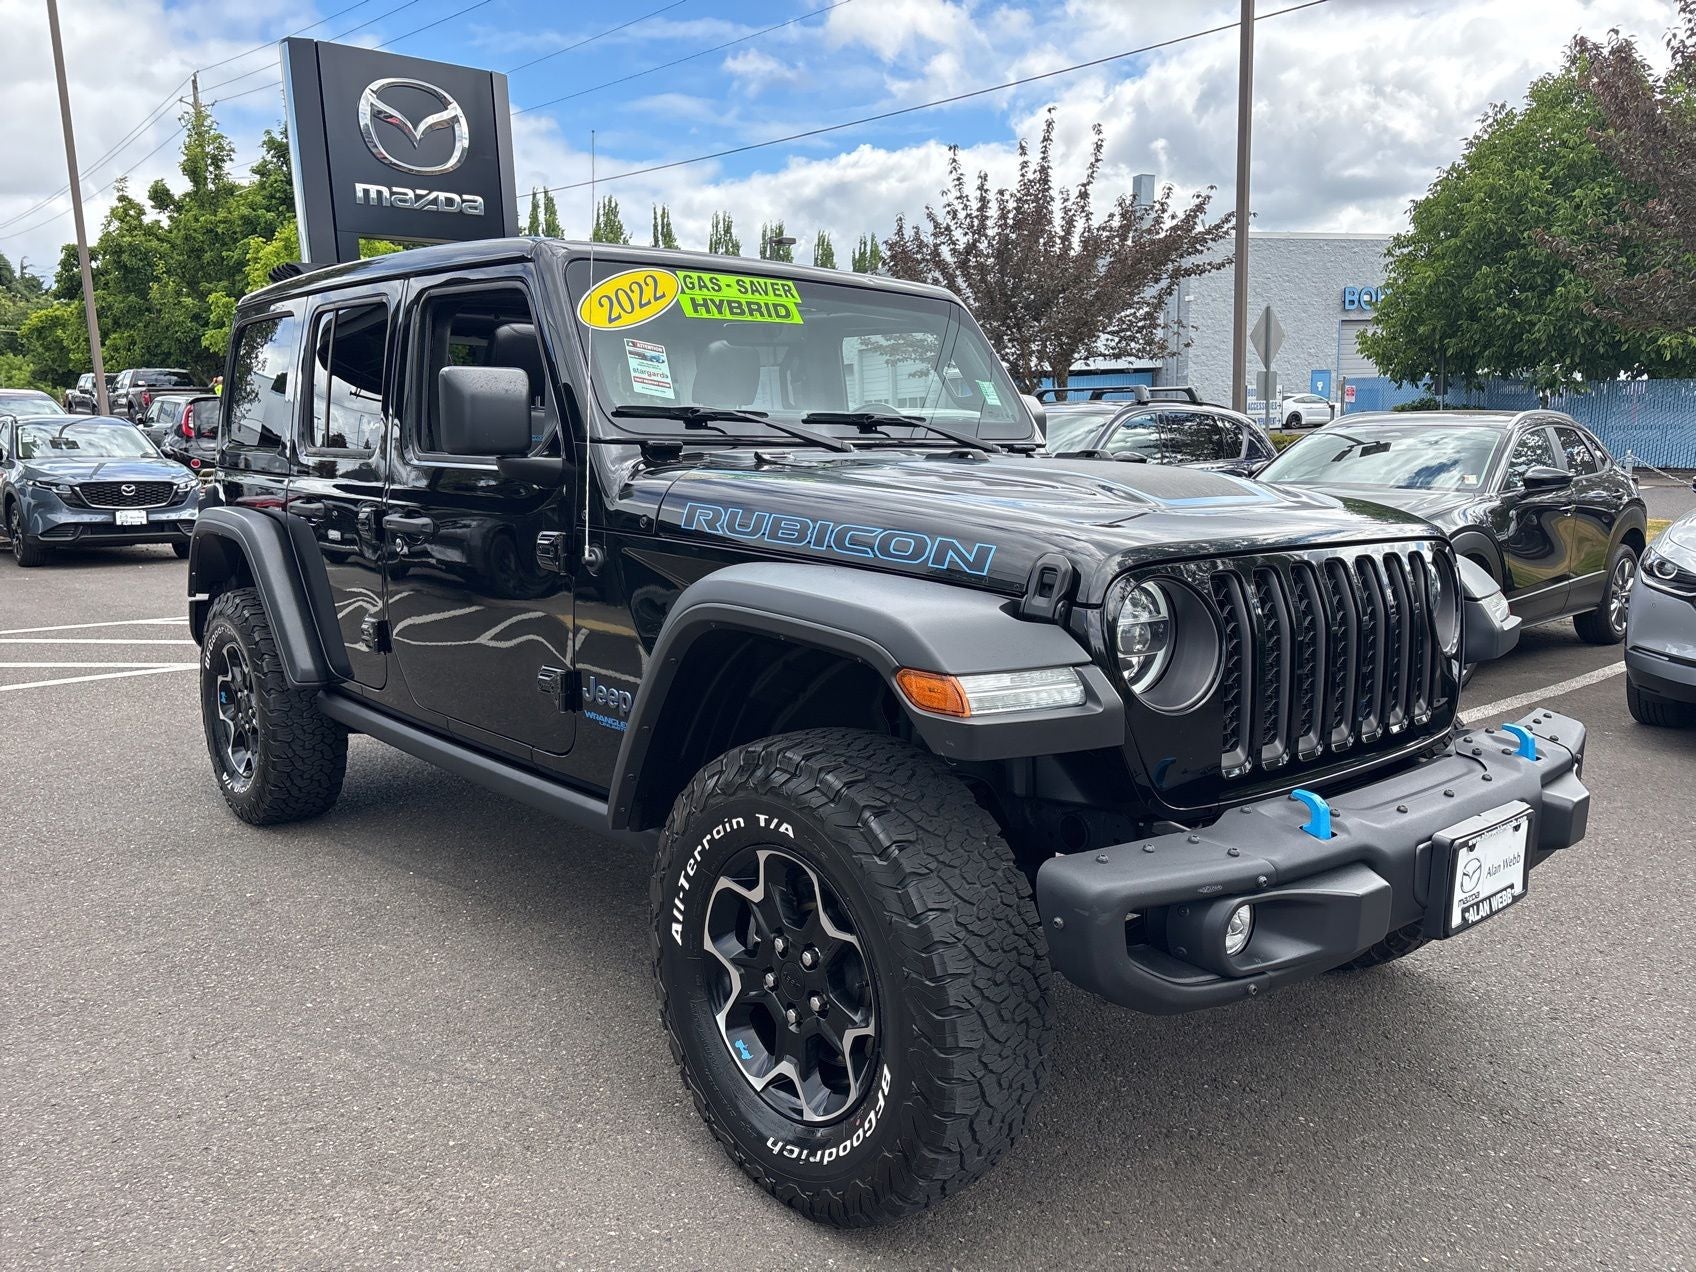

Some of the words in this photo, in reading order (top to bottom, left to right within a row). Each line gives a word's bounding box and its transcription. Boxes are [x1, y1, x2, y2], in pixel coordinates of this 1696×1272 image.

[354, 182, 485, 216] mazda
[598, 274, 666, 324] 2022
[683, 274, 722, 293] GAS
[736, 279, 796, 299] SAVER
[692, 297, 793, 320] HYBRID
[1248, 402, 1277, 411] ACCESSES
[681, 502, 997, 576] RUBICON
[582, 676, 632, 717] Jeep
[584, 710, 628, 728] WRANGLE
[671, 816, 745, 947] All-Terrain
[755, 813, 795, 839] T/A
[1486, 863, 1501, 879] Alan
[1502, 853, 1521, 869] Webb
[1468, 898, 1490, 924] ALAN
[1490, 888, 1513, 912] WEBB
[766, 1063, 891, 1165] BFGoodrich
